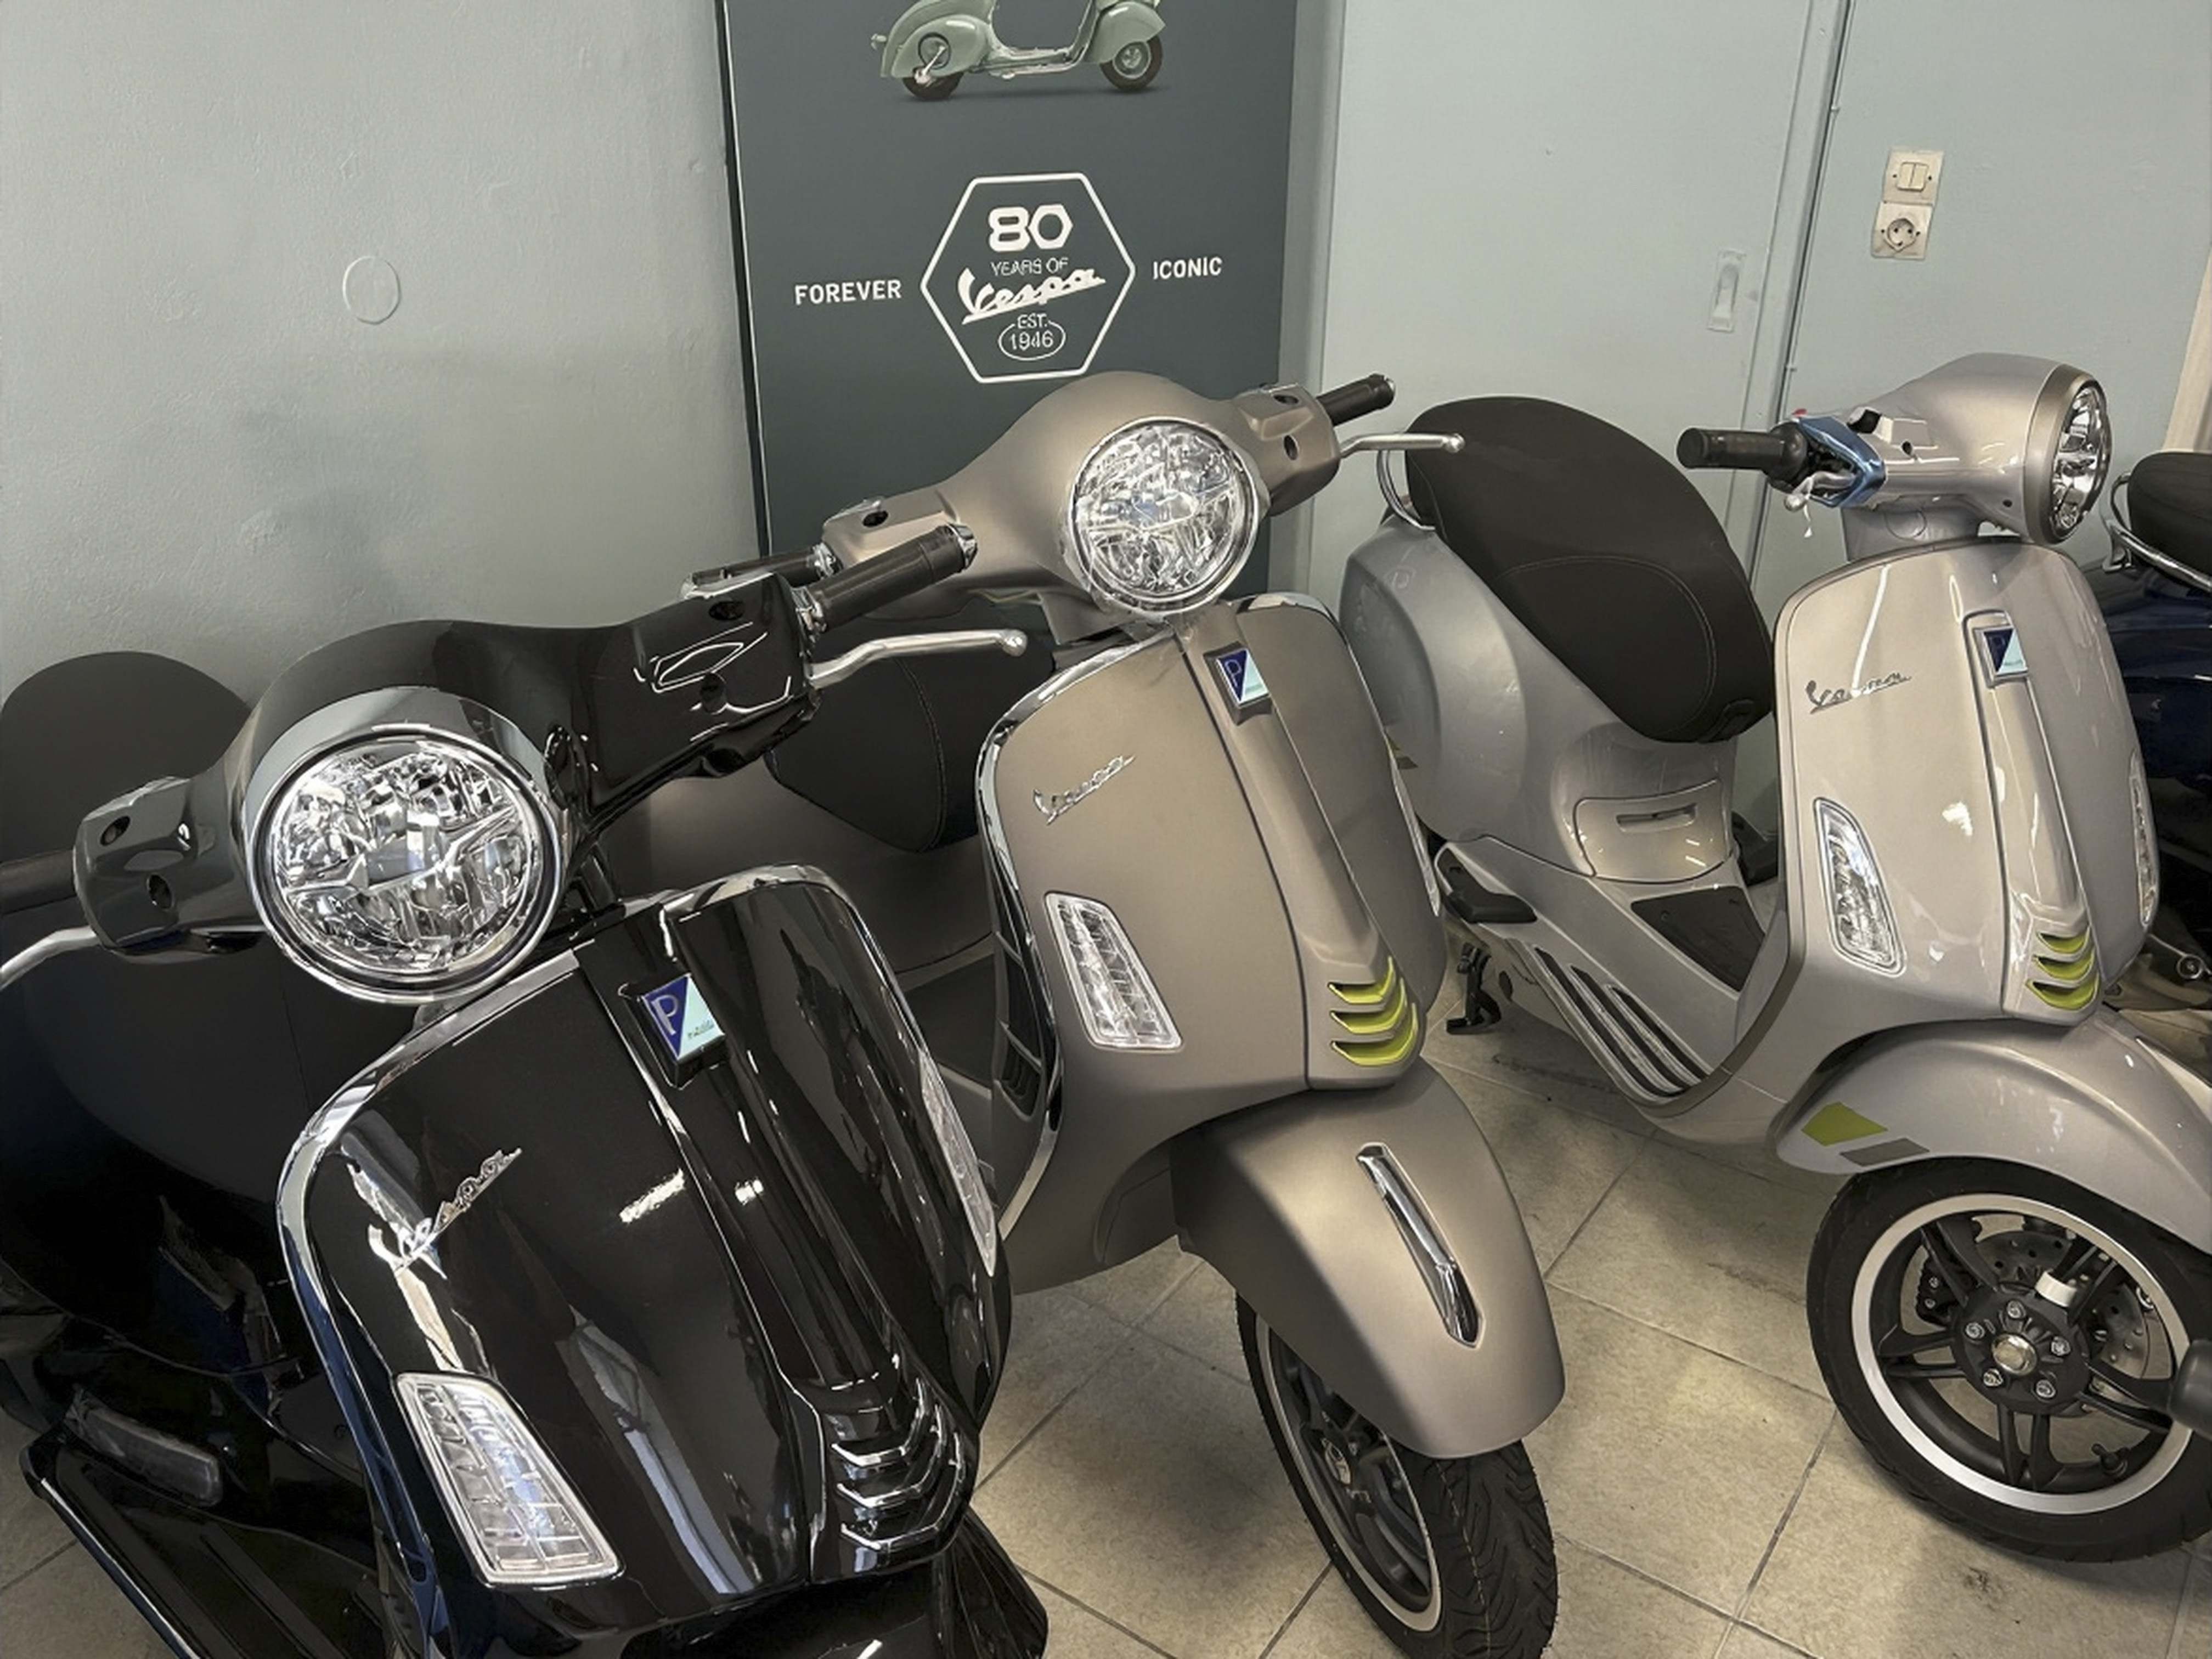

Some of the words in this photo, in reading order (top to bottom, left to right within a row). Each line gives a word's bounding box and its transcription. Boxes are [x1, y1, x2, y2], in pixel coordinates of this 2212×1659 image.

[989, 204, 1074, 252] 80
[990, 258, 1042, 276] YEARS
[1046, 257, 1069, 274] OF
[1153, 256, 1223, 280] ICONIC
[794, 279, 902, 305] FOREVER
[957, 267, 1106, 325] Vespa
[1009, 330, 1054, 351] 1946
[650, 994, 678, 1035] P
